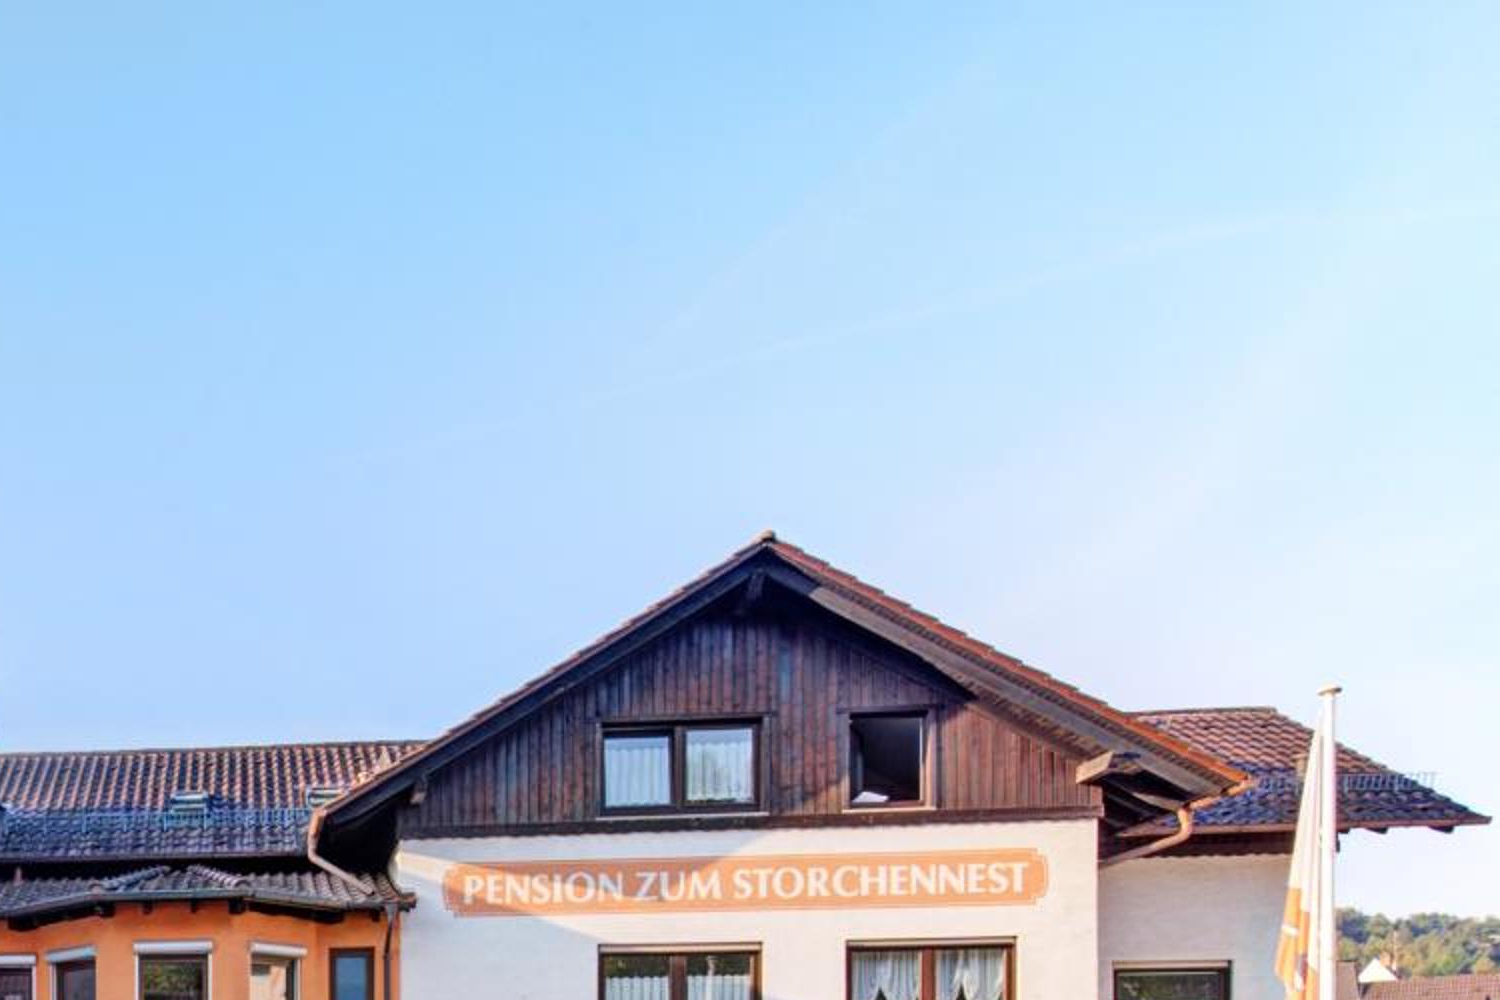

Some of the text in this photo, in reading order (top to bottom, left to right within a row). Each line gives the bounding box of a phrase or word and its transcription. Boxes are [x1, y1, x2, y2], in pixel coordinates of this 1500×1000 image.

[464, 861, 1029, 905] PENSION ZUM STORCHENNEST
